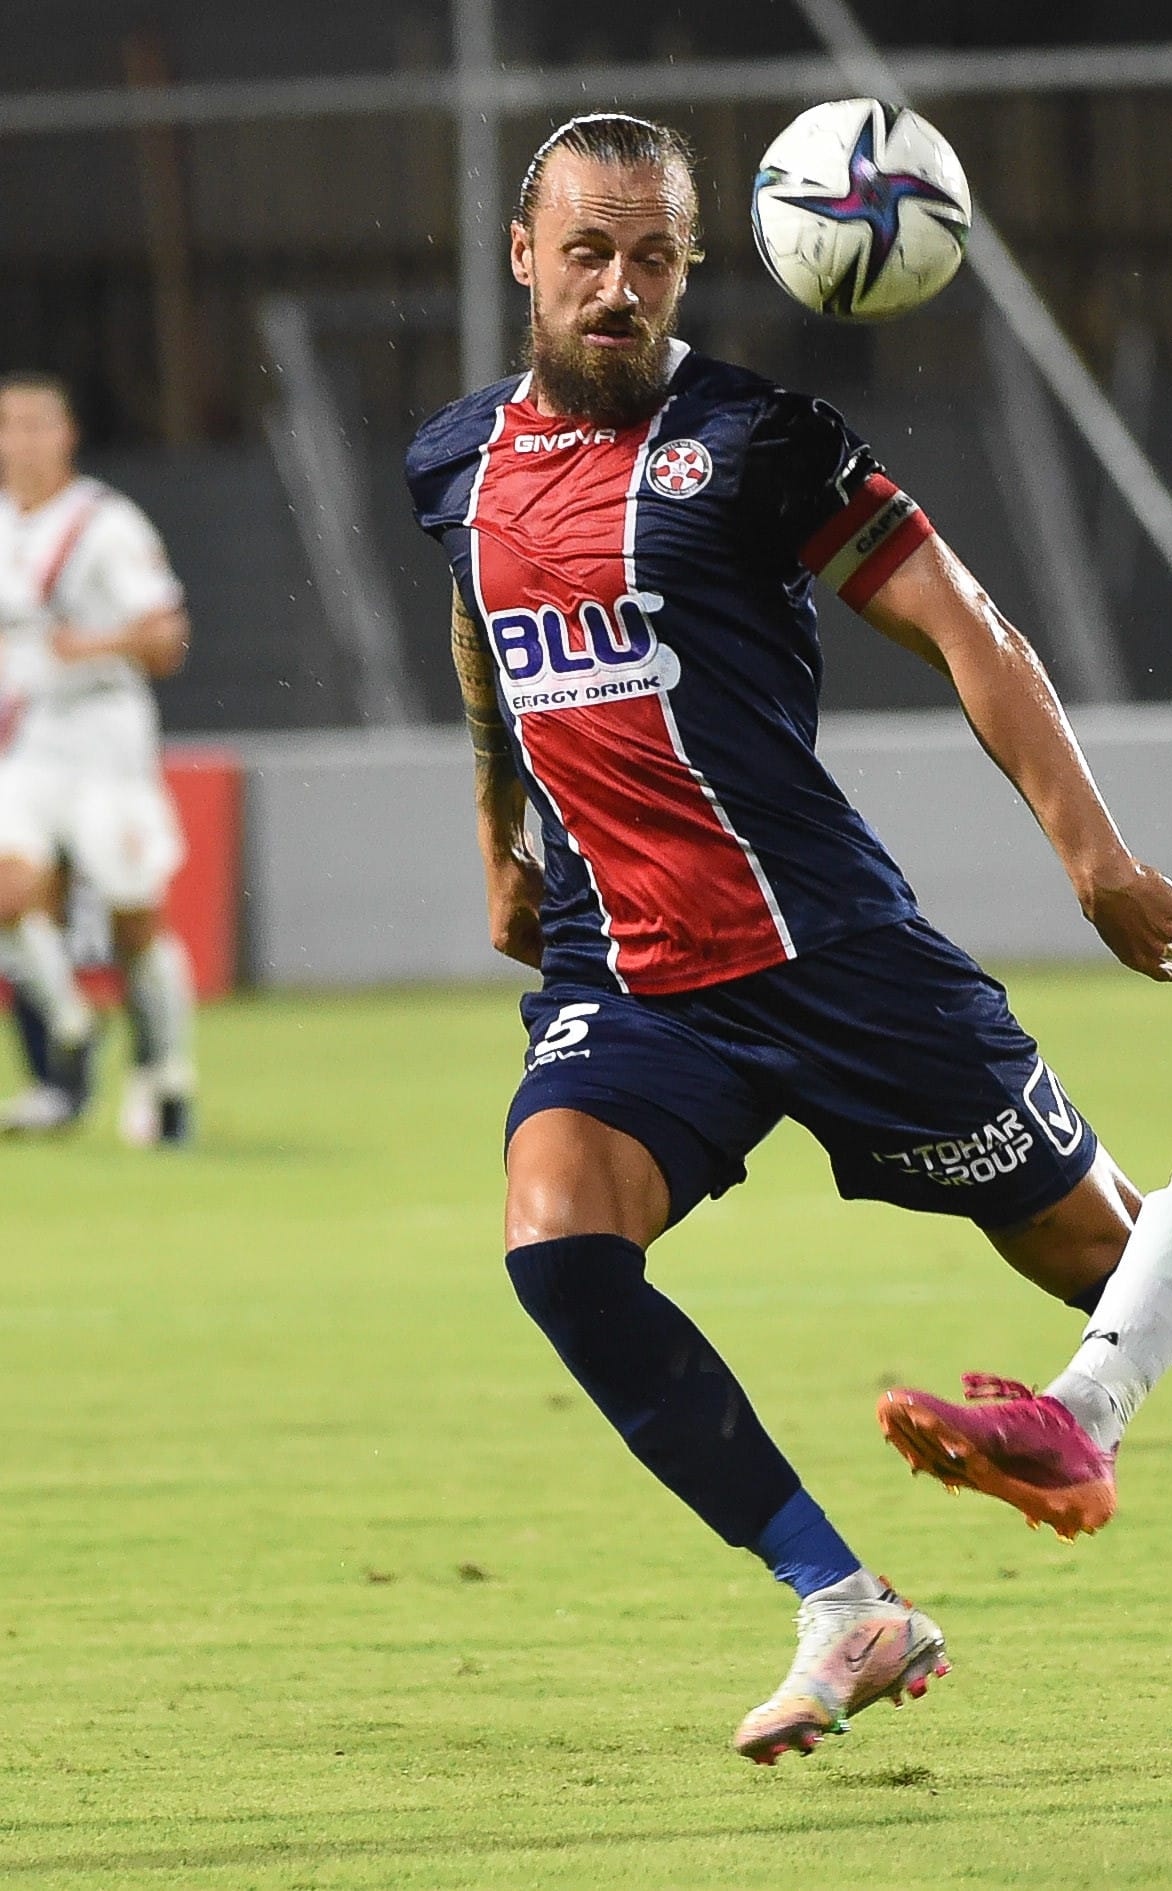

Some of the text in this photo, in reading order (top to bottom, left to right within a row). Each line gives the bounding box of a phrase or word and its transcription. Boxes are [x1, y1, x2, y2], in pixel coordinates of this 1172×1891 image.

[514, 428, 617, 453] GIVOVA
[491, 601, 652, 681] BLU
[585, 675, 661, 699] DRINK
[534, 1002, 600, 1057] 5
